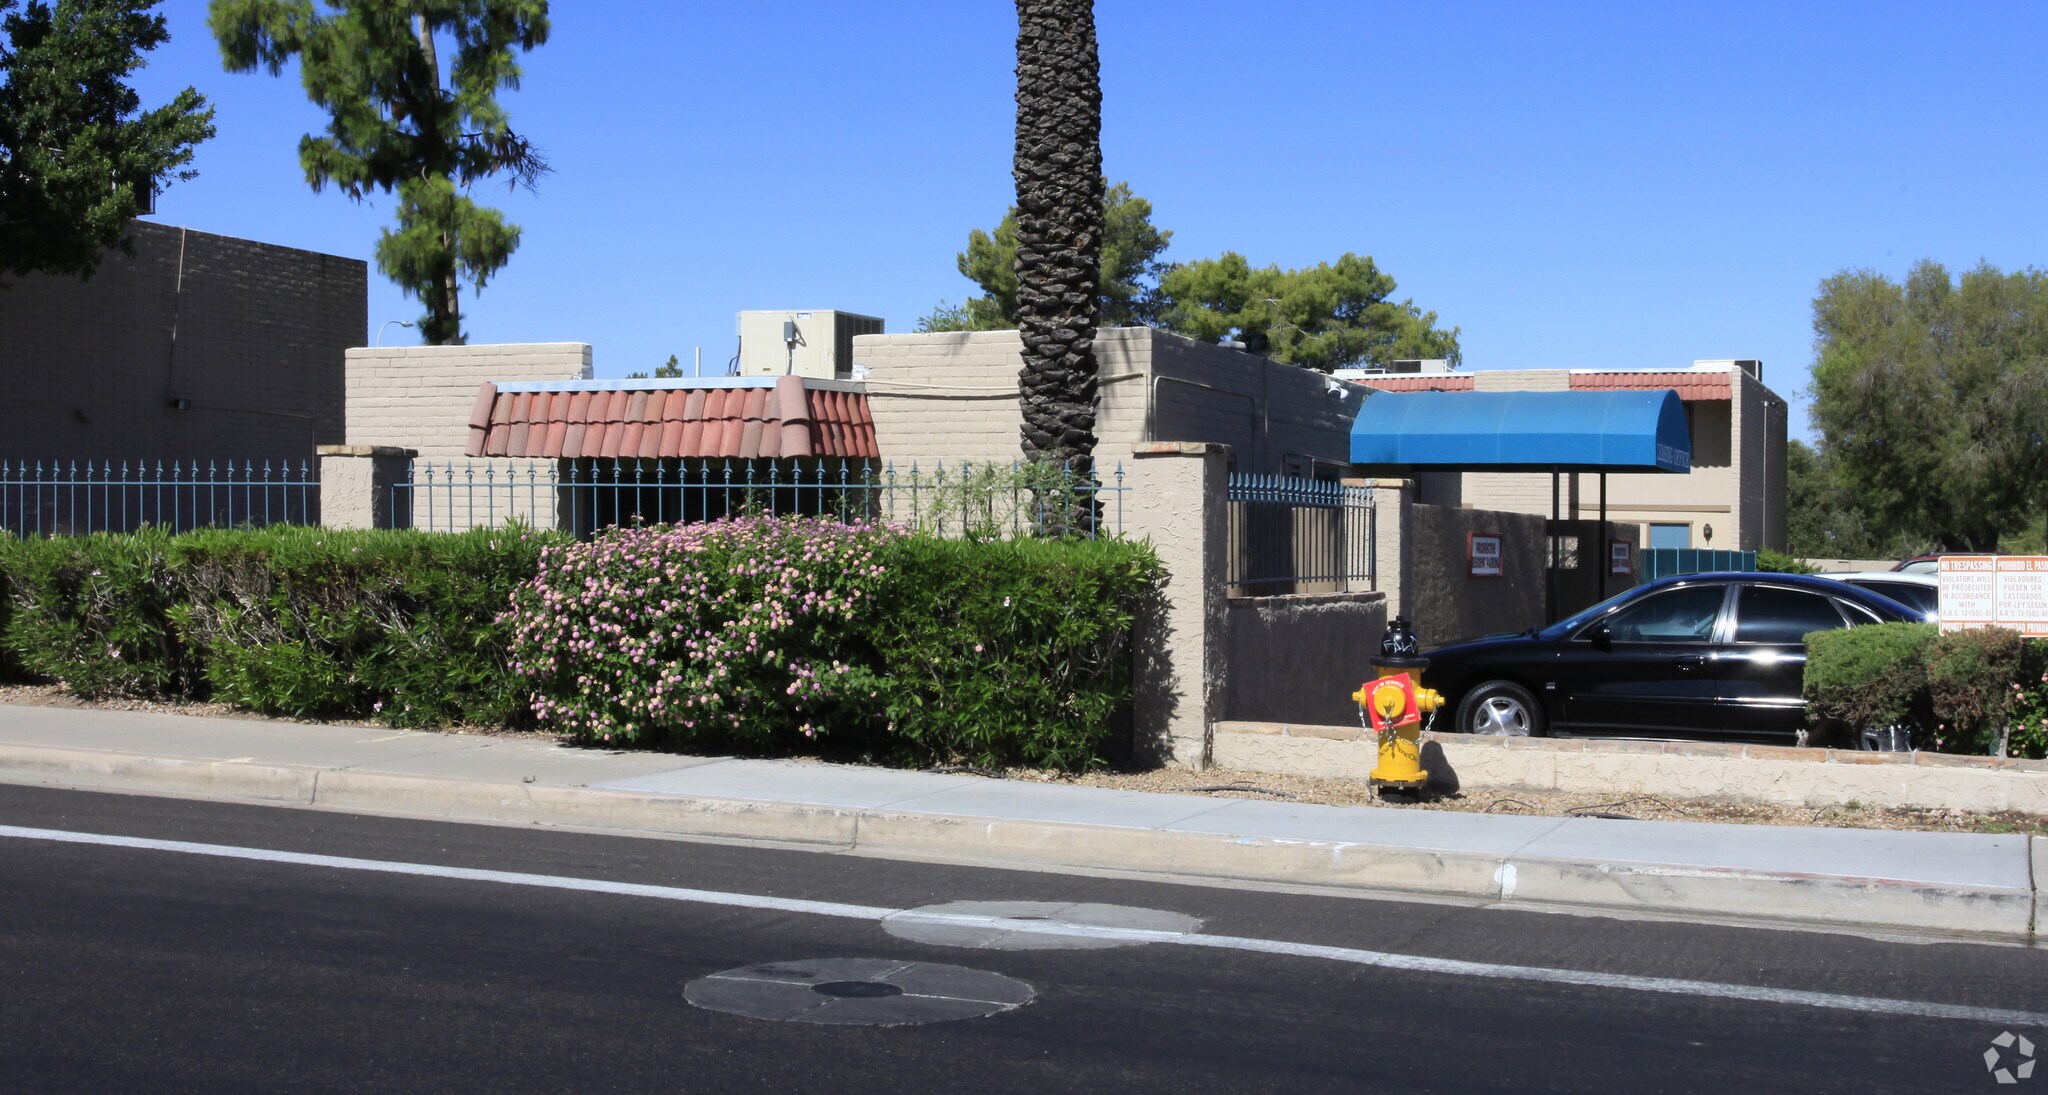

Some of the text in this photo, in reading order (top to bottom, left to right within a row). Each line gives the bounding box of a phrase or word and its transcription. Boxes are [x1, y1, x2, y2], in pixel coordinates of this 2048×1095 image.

[1941, 560, 1992, 571] NO TRESPASSING
[2026, 560, 2033, 571] EL
[2034, 560, 2048, 571] PASO
[1942, 575, 1991, 583] VIOLATORS WILL
[2003, 575, 2042, 583] VIOLADORES
[1942, 592, 1991, 600] IN ACCORDANCE
[2003, 592, 2042, 600] CASTIGADOS
[1371, 685, 1380, 696] NOT
[1384, 680, 1405, 689] SERVICE
